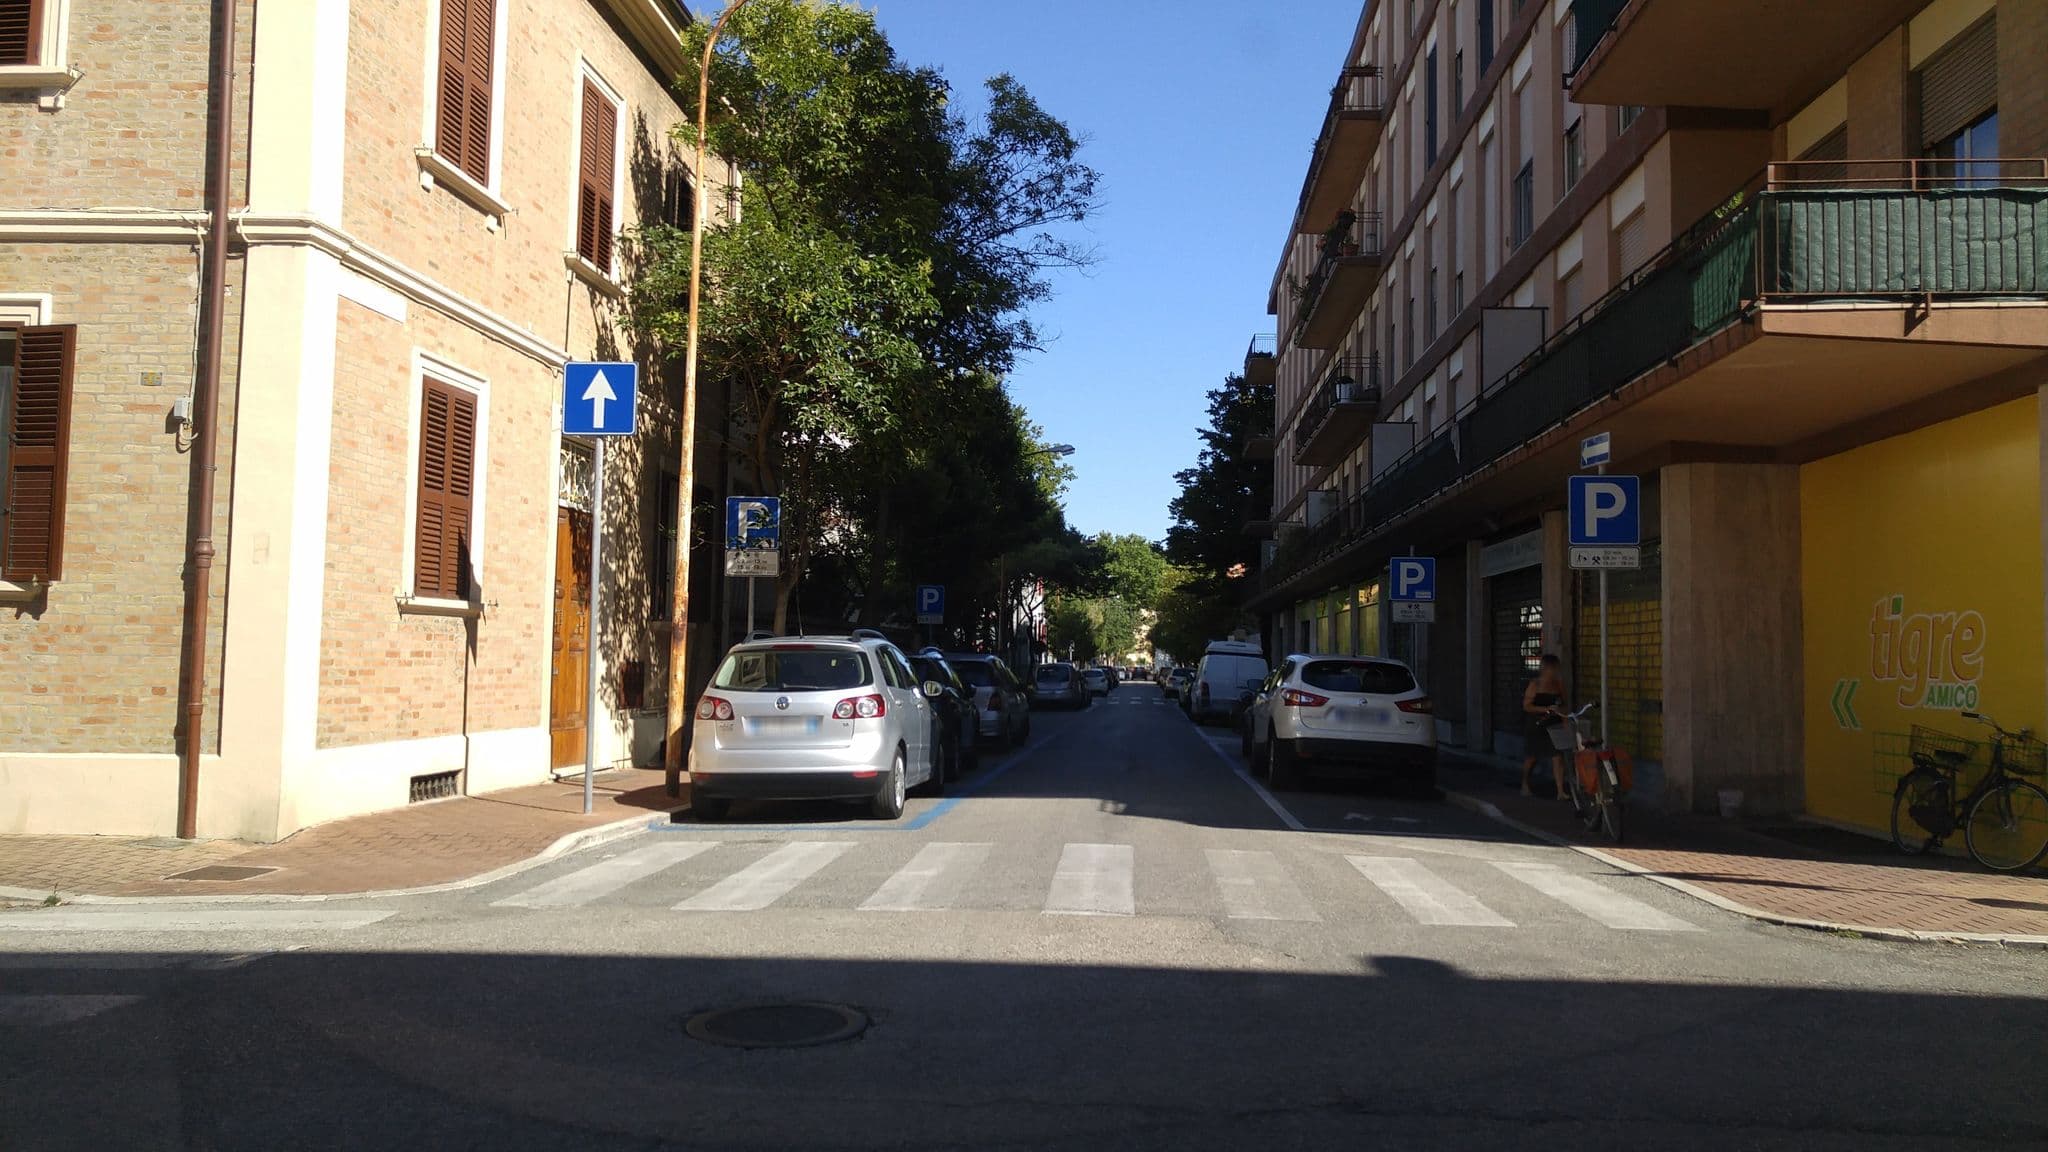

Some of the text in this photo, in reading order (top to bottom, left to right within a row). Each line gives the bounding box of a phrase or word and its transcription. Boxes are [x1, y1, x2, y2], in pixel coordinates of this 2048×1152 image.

[738, 502, 769, 543] P
[1585, 483, 1626, 536] P
[1400, 562, 1425, 595] P
[923, 589, 939, 610] P
[1871, 595, 1985, 708] tigre
[1926, 684, 1977, 708] AMICO
